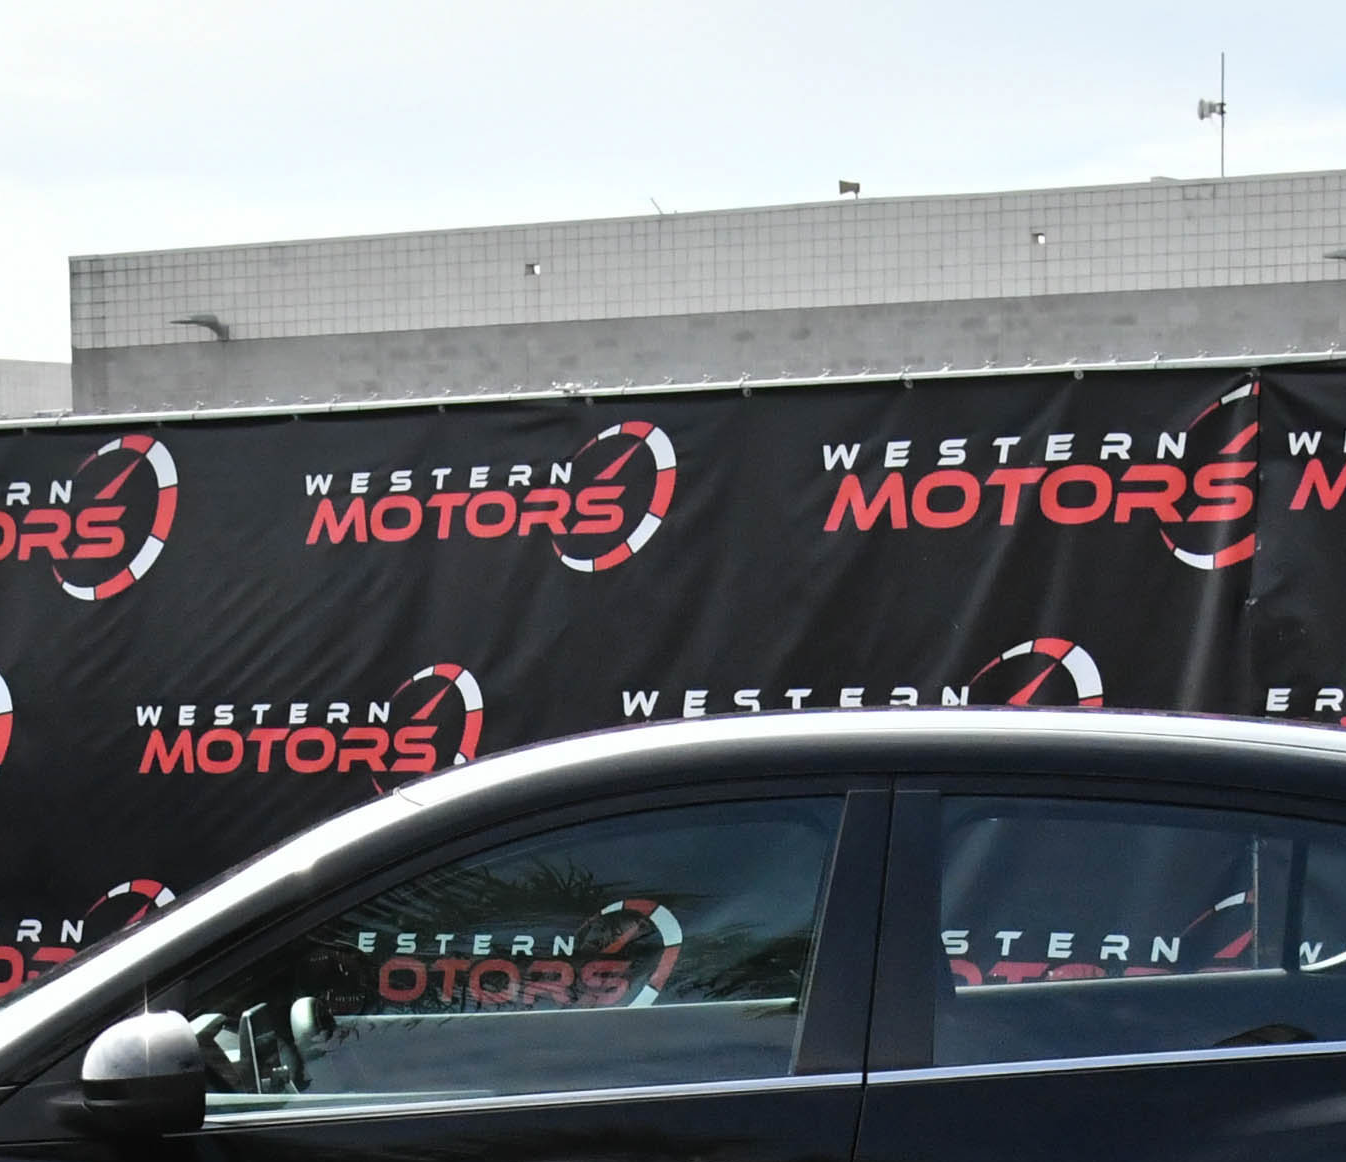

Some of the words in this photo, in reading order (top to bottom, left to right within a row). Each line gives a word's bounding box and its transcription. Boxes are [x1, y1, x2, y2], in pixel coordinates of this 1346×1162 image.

[822, 431, 1187, 471] WESTERN
[305, 461, 573, 497] WESTERN
[823, 460, 1257, 532] MOTORS
[306, 484, 626, 545] MOTORS
[136, 701, 391, 727] WESTERN
[138, 724, 438, 775] MOTORS
[357, 932, 575, 956] ESTERN
[940, 930, 1181, 963] STERN
[378, 957, 630, 1003] OTORS
